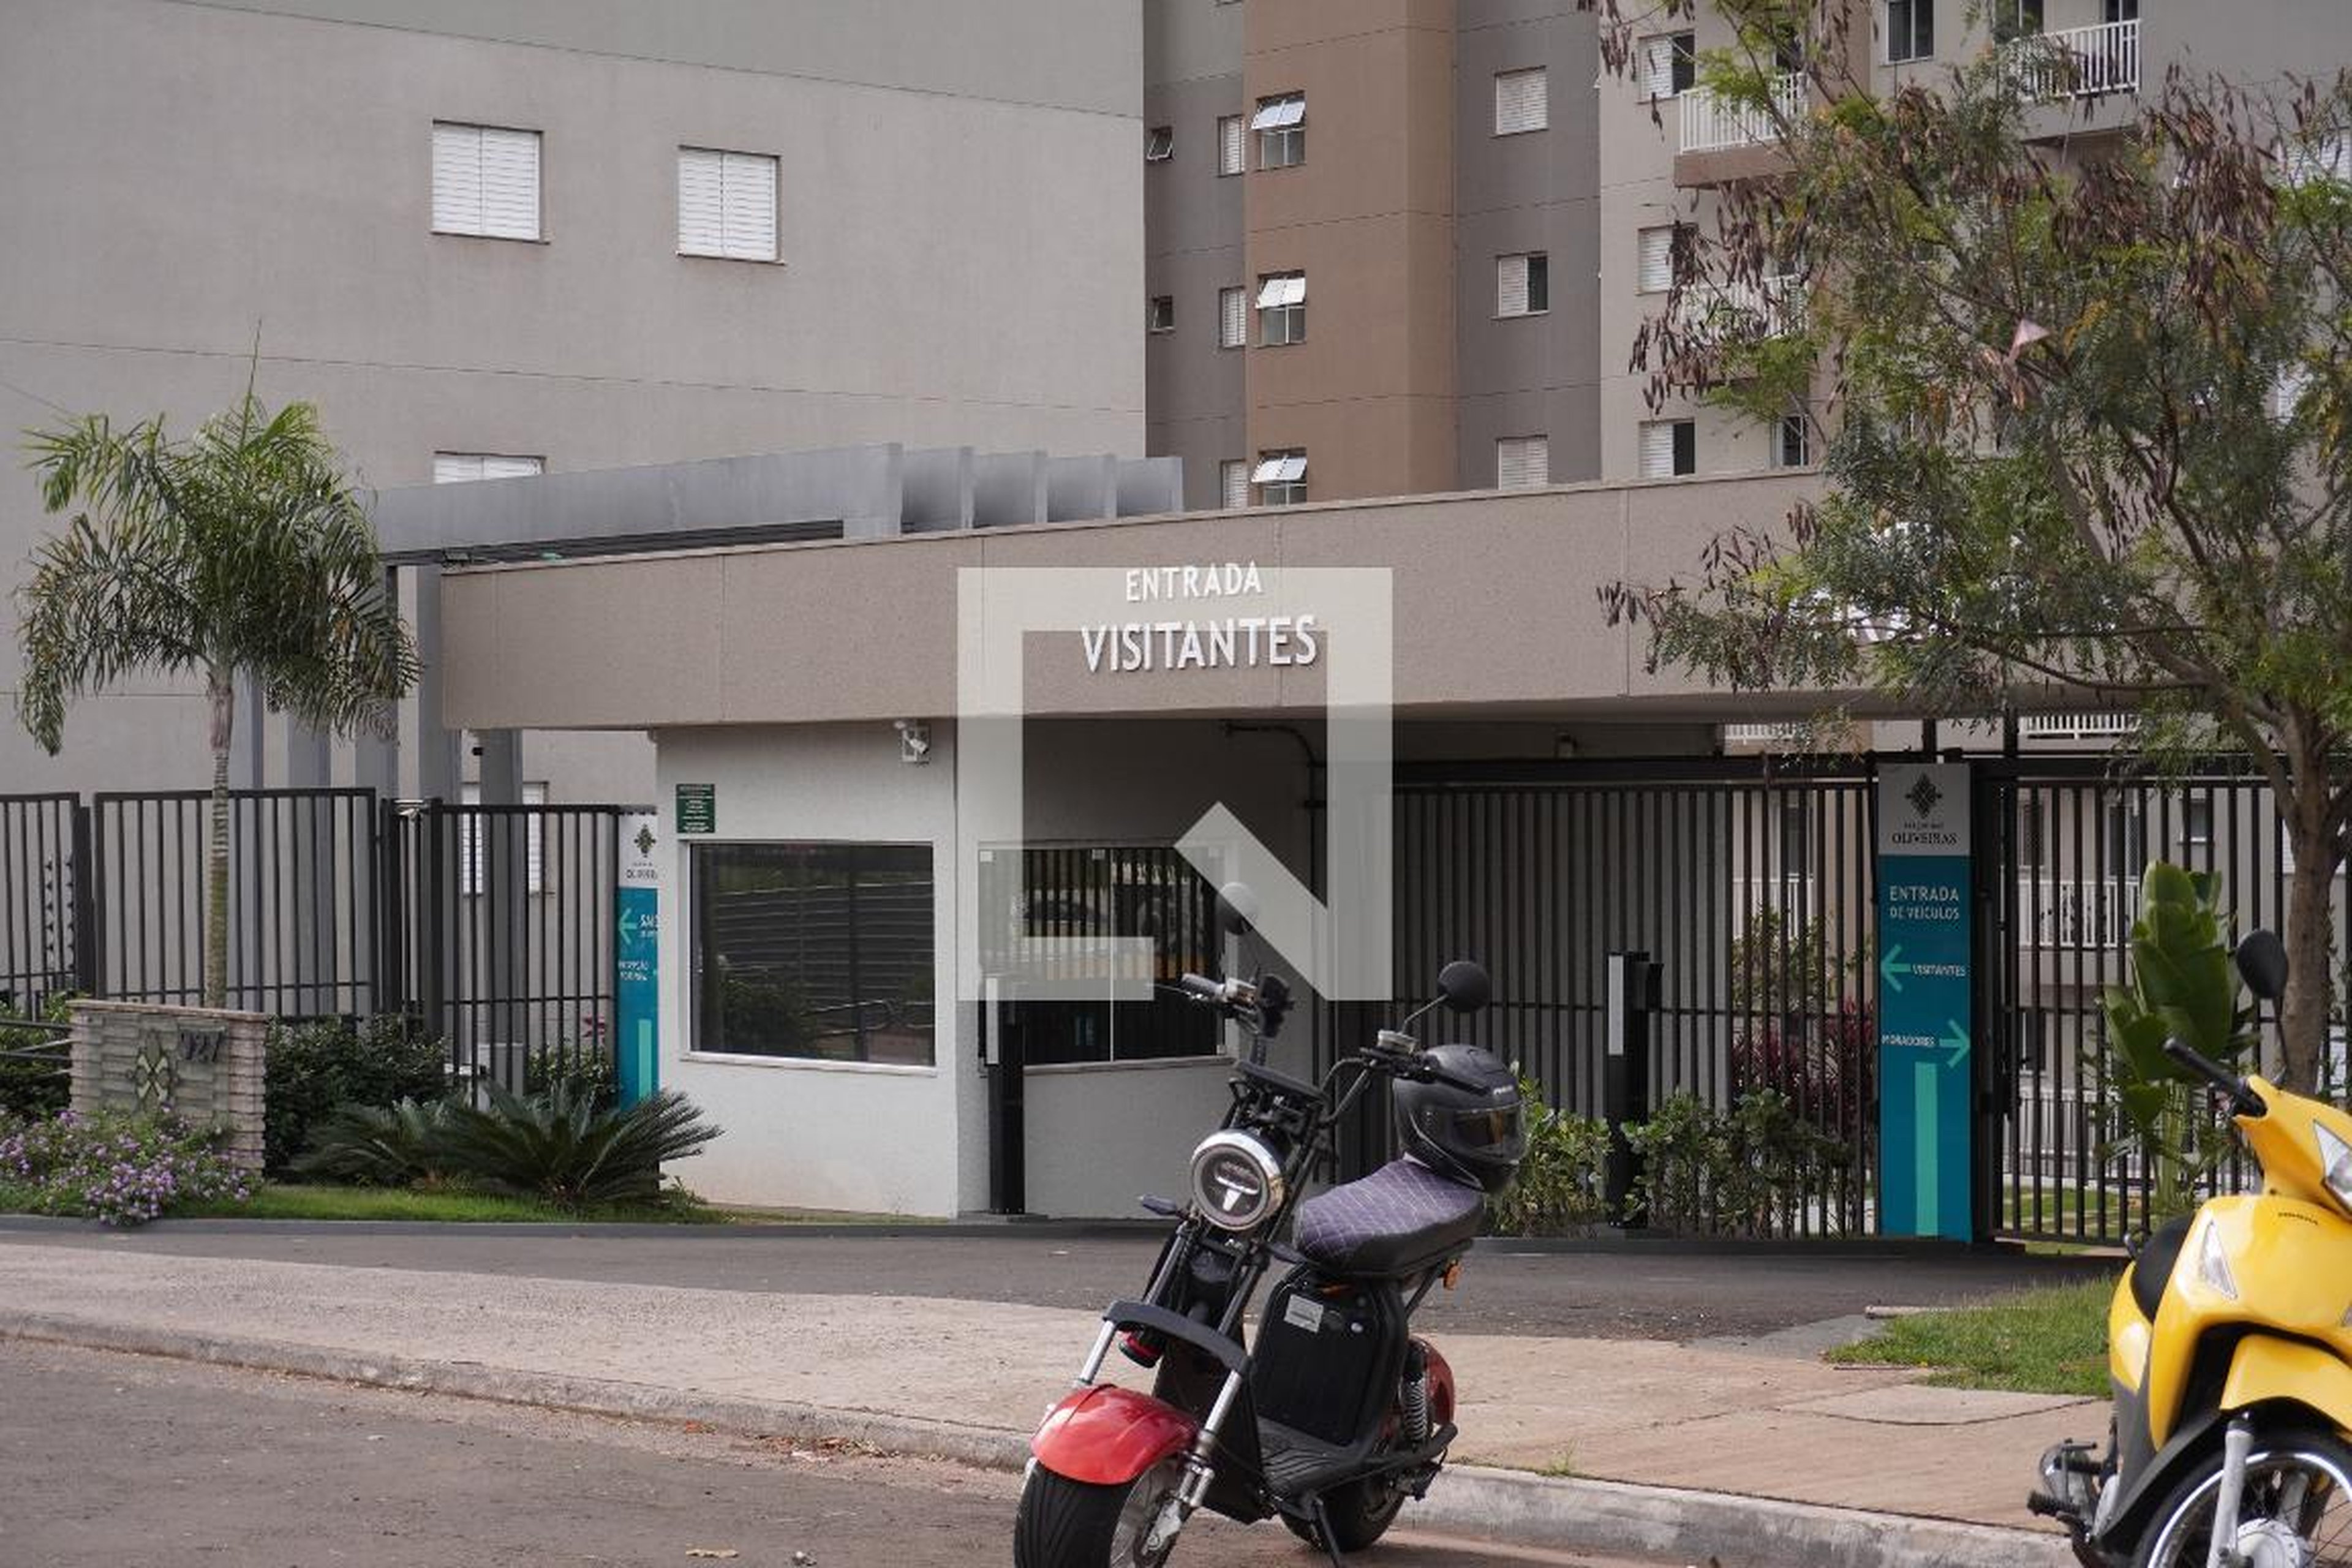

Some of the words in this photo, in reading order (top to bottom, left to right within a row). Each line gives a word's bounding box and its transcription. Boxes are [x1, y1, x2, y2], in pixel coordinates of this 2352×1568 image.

[1126, 561, 1262, 601] ENTRADA
[1081, 614, 1317, 673] VISITANTES
[1889, 885, 1959, 901] ENTRADA
[1912, 963, 1966, 976] VISITANTES
[1881, 1034, 1936, 1047] MORADORES
